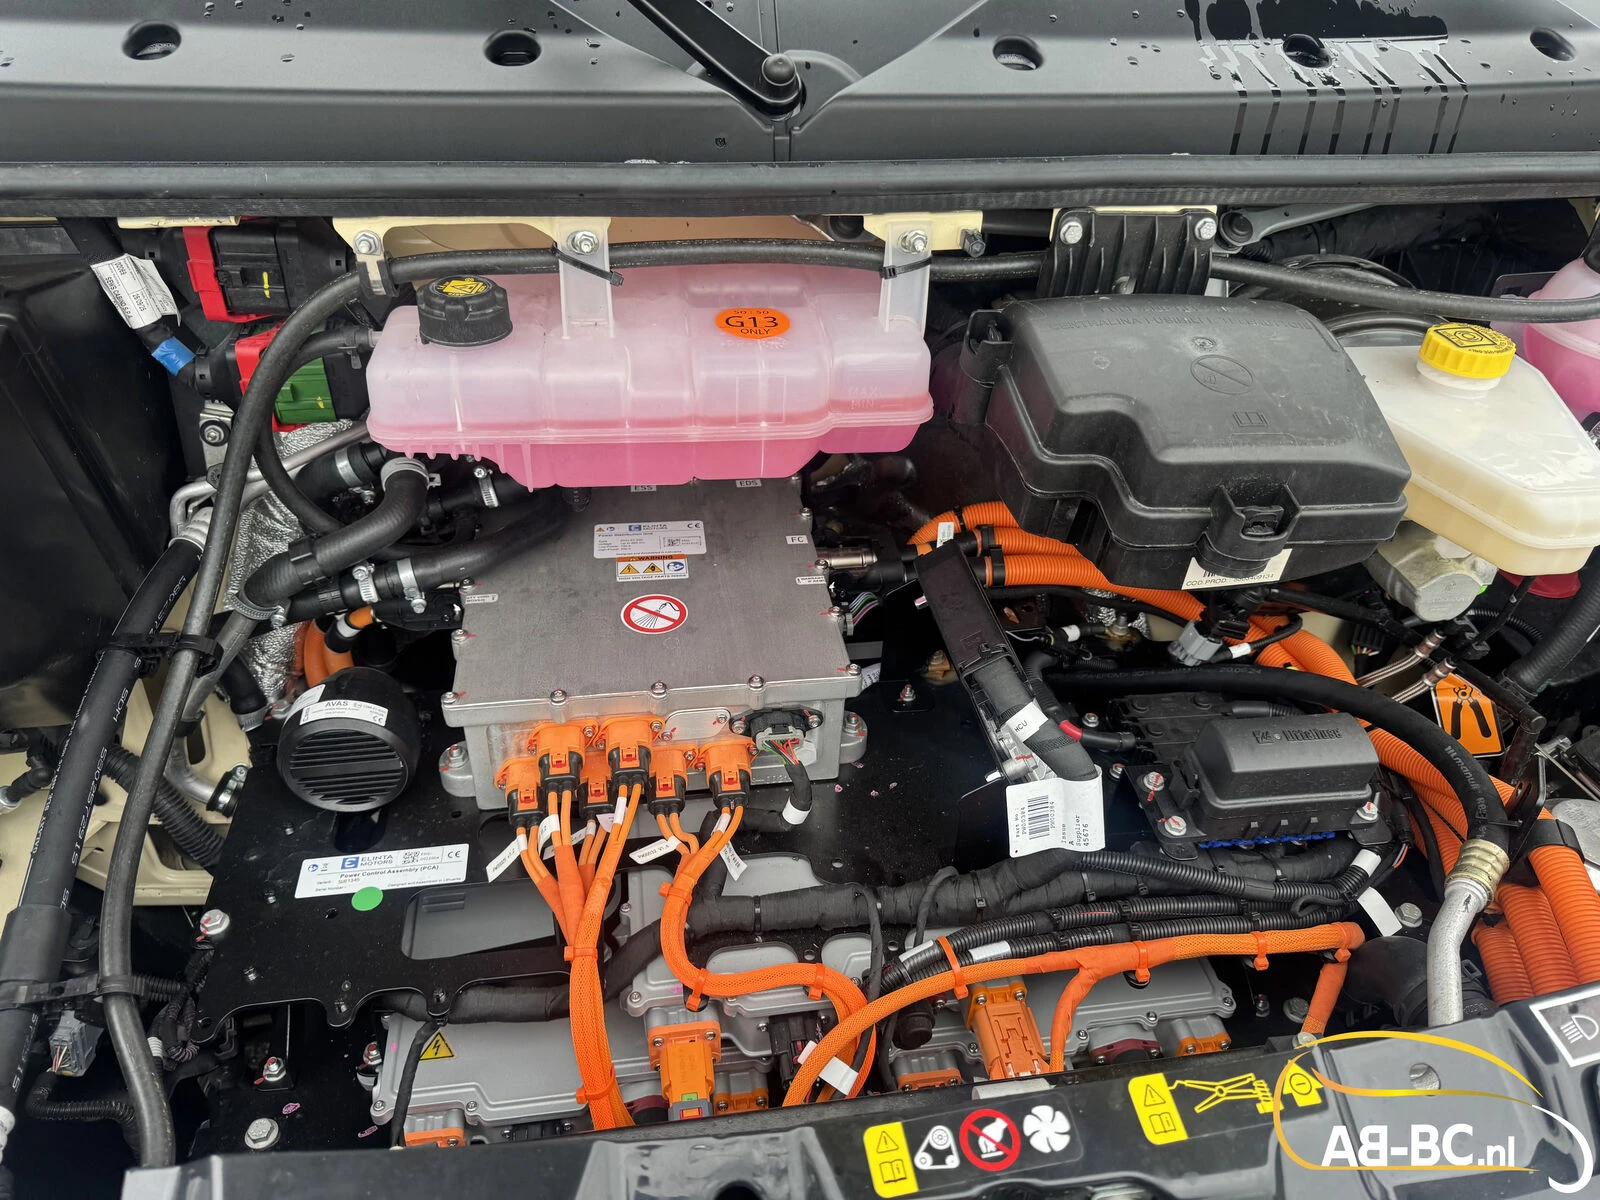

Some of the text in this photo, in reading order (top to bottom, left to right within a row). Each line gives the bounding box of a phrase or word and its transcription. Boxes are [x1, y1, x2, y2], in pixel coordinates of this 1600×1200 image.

[725, 315, 779, 328] G13
[791, 536, 804, 544] FC
[361, 854, 394, 862] ELINTA
[360, 859, 394, 867] MOTORS
[362, 870, 386, 878] Control
[386, 867, 420, 876] Assembly
[420, 864, 440, 872] (PCA)
